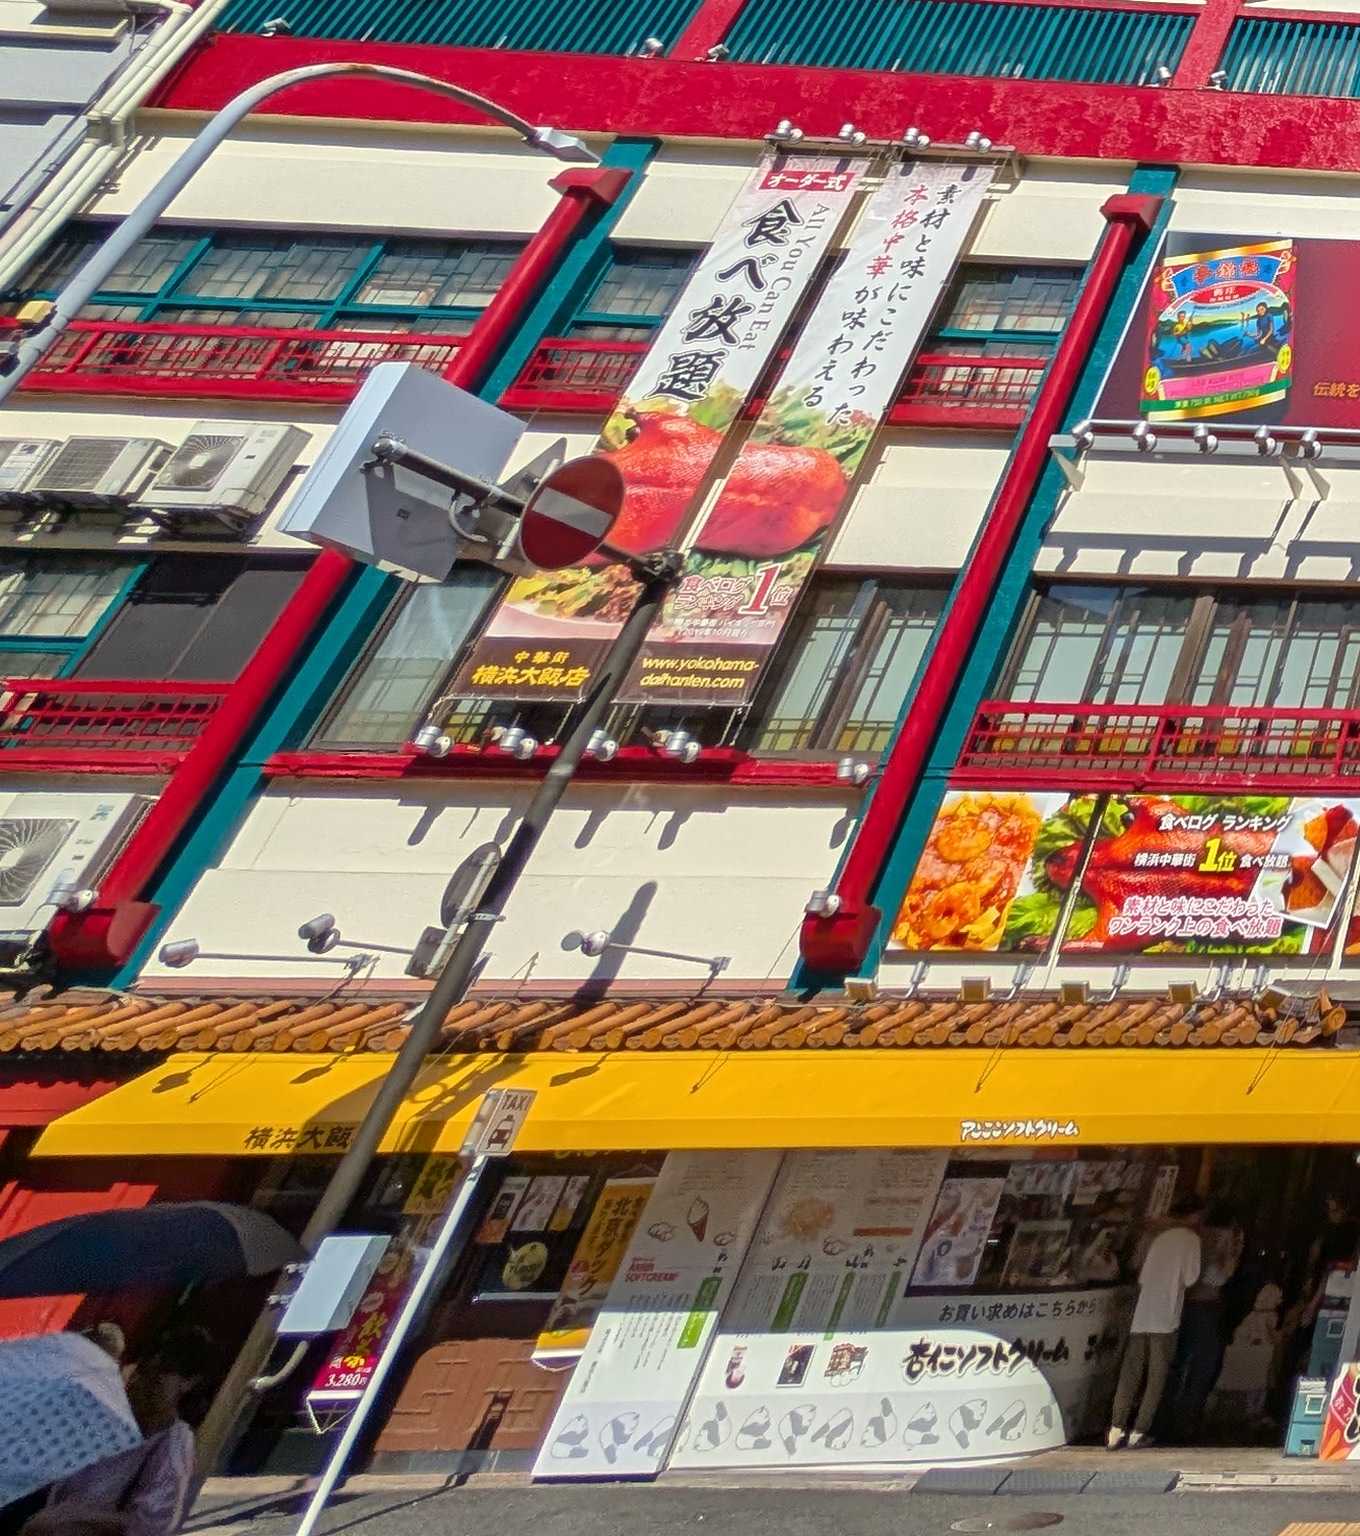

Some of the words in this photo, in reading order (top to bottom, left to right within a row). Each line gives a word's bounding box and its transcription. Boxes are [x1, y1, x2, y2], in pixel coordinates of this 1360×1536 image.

[767, 172, 849, 192] オーダー式
[804, 202, 831, 231] All
[778, 237, 813, 274] You
[643, 198, 804, 402] 食べ放題
[757, 279, 791, 315] Can
[803, 184, 930, 409] 本格中華が味わえる
[826, 184, 964, 426] 素材と味にこだわった
[738, 319, 771, 351] Eat
[678, 574, 754, 596] 食べログ
[471, 665, 590, 688] 横浜大飯店
[641, 655, 760, 673] www.yokohama-
[639, 674, 745, 690] daihanten.com
[1159, 813, 1219, 831] 食べログ
[1222, 814, 1293, 832] ランキング
[1134, 852, 1197, 869] 横浜中華街
[1197, 837, 1238, 873] 1位
[1239, 854, 1290, 869] 食べ放題
[1122, 895, 1275, 917] 素材と味にこだわった
[1108, 916, 1285, 939] ワンランク上の食べ放題
[500, 1093, 532, 1112] TAXI
[243, 1125, 356, 1151] 横浜大飯
[937, 1297, 1098, 1323] お買い求めはこちらから
